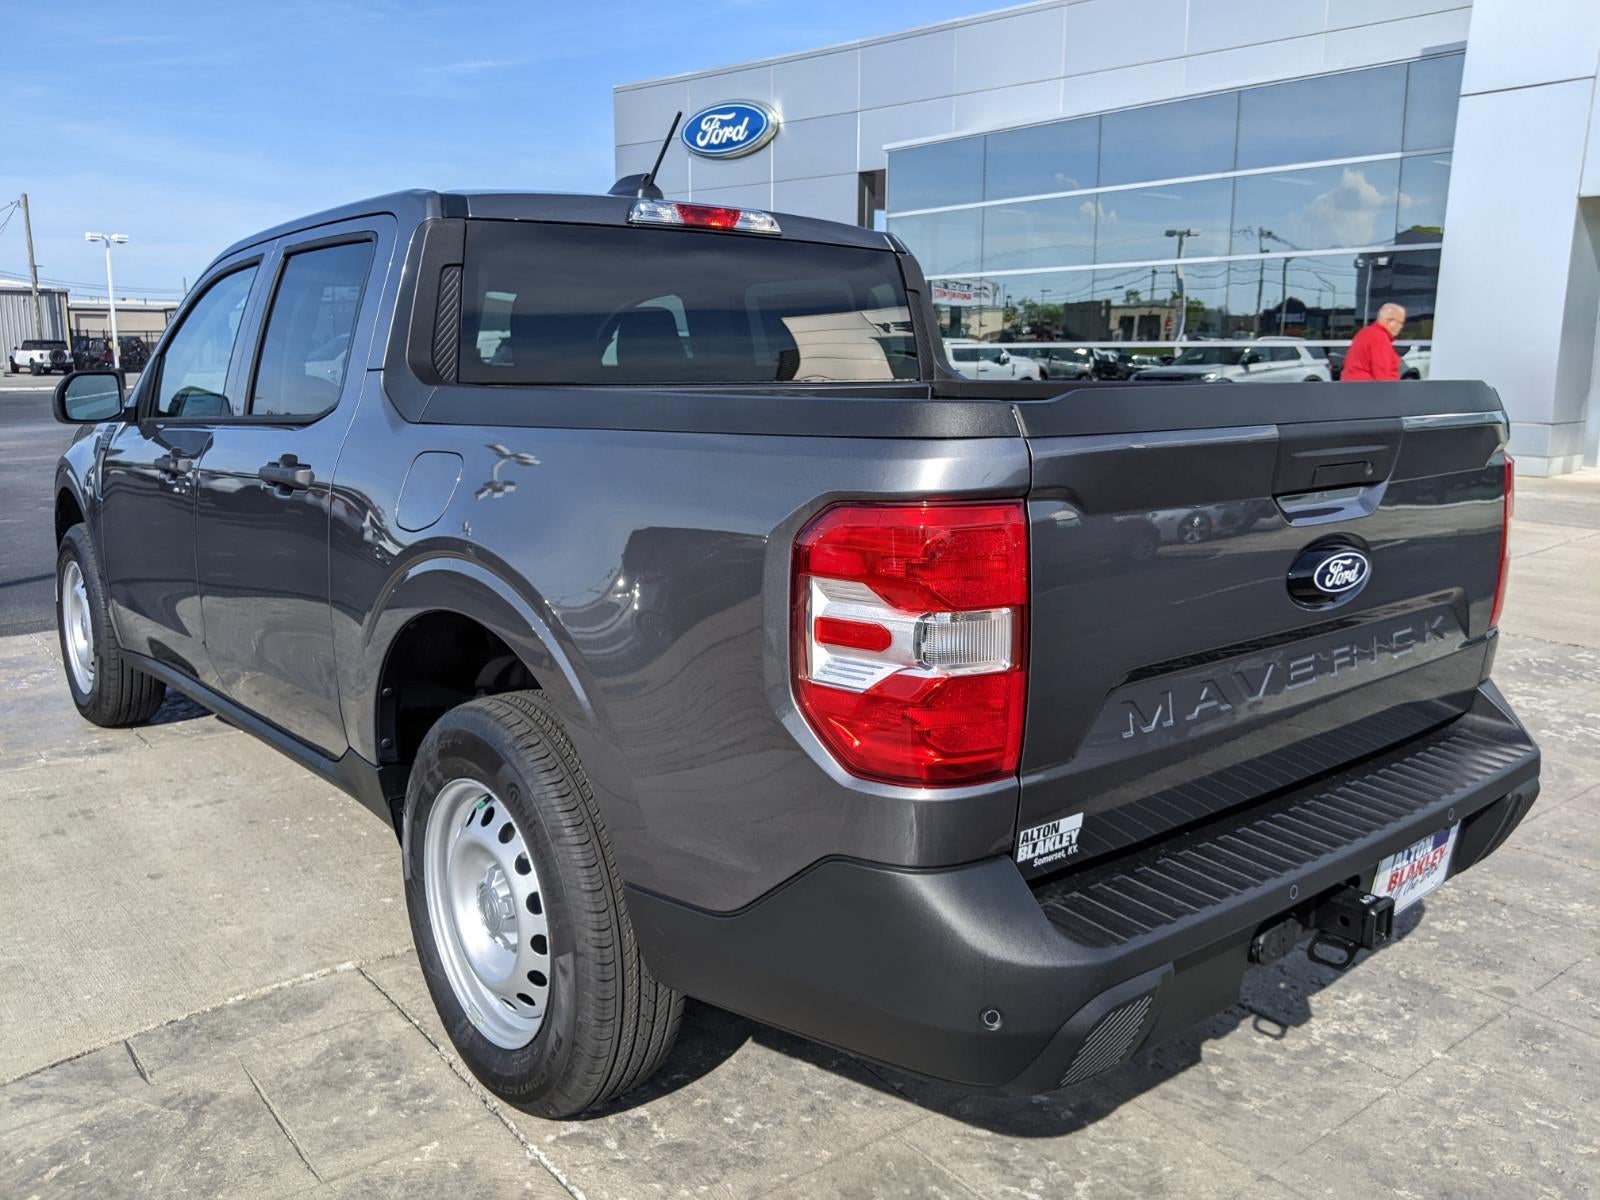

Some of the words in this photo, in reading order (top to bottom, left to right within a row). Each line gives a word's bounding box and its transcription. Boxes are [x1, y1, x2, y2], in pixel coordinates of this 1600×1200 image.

[696, 112, 750, 147] Ford
[1325, 558, 1361, 587] Ford
[1120, 615, 1446, 738] MAVERICK
[1016, 829, 1081, 863] BLAKLEY
[1020, 820, 1060, 845] ALTON
[1386, 845, 1448, 893] BLAKLEY
[1391, 835, 1435, 872] ALTON
